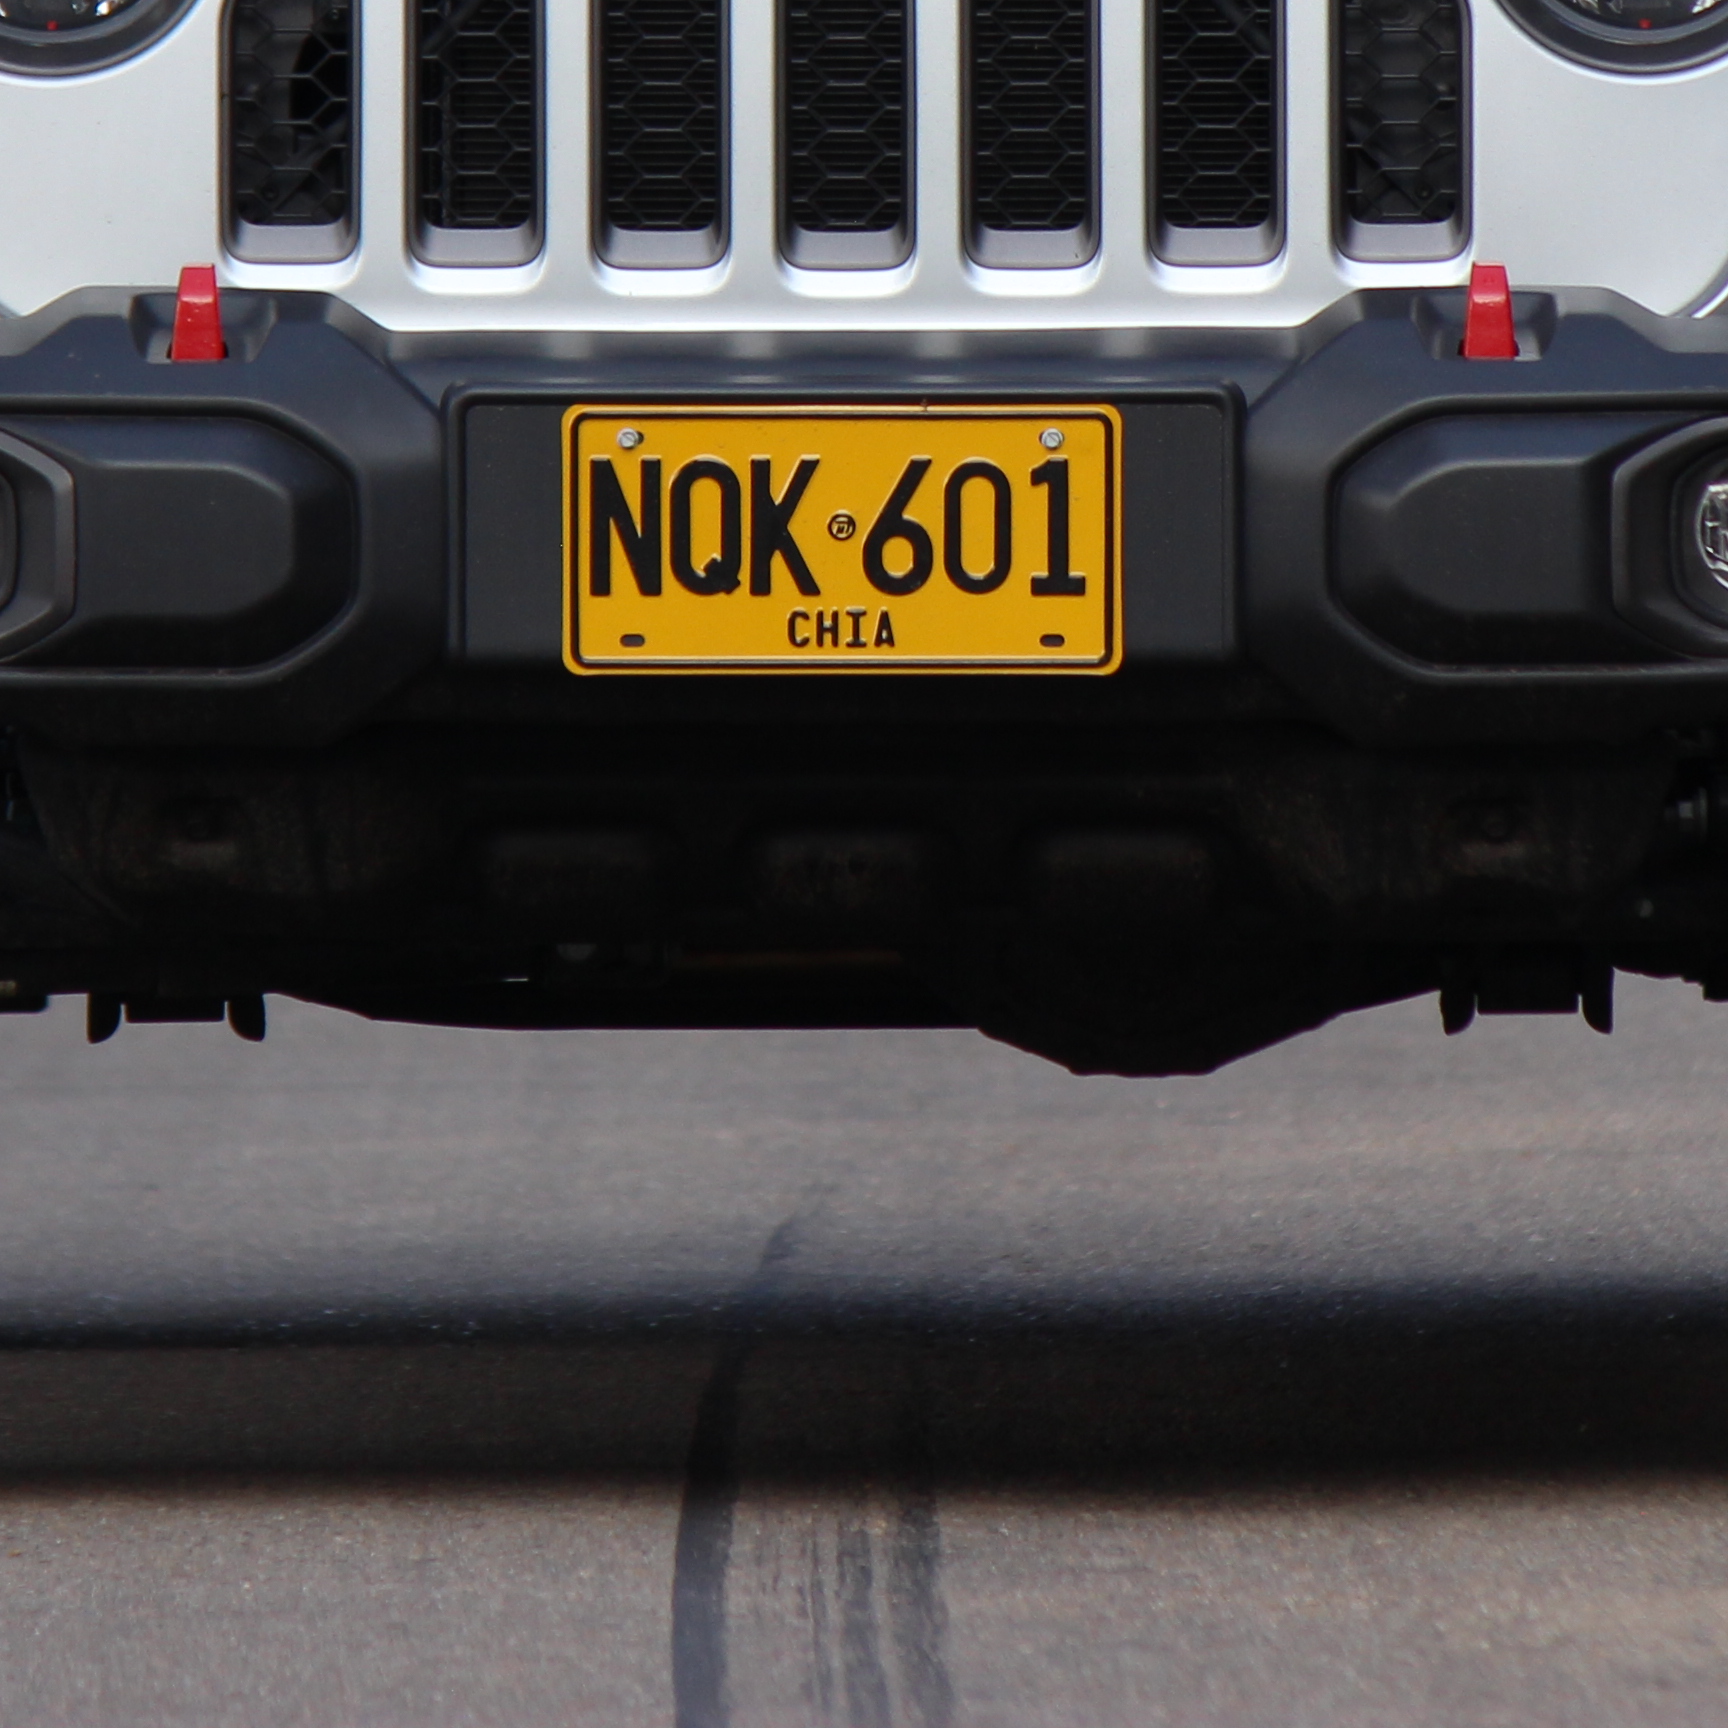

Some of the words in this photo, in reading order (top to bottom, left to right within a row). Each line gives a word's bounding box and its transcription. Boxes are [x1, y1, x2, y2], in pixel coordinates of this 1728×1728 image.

[589, 455, 821, 597] NQK
[861, 455, 1087, 597] 601
[786, 607, 895, 648] CHIA
